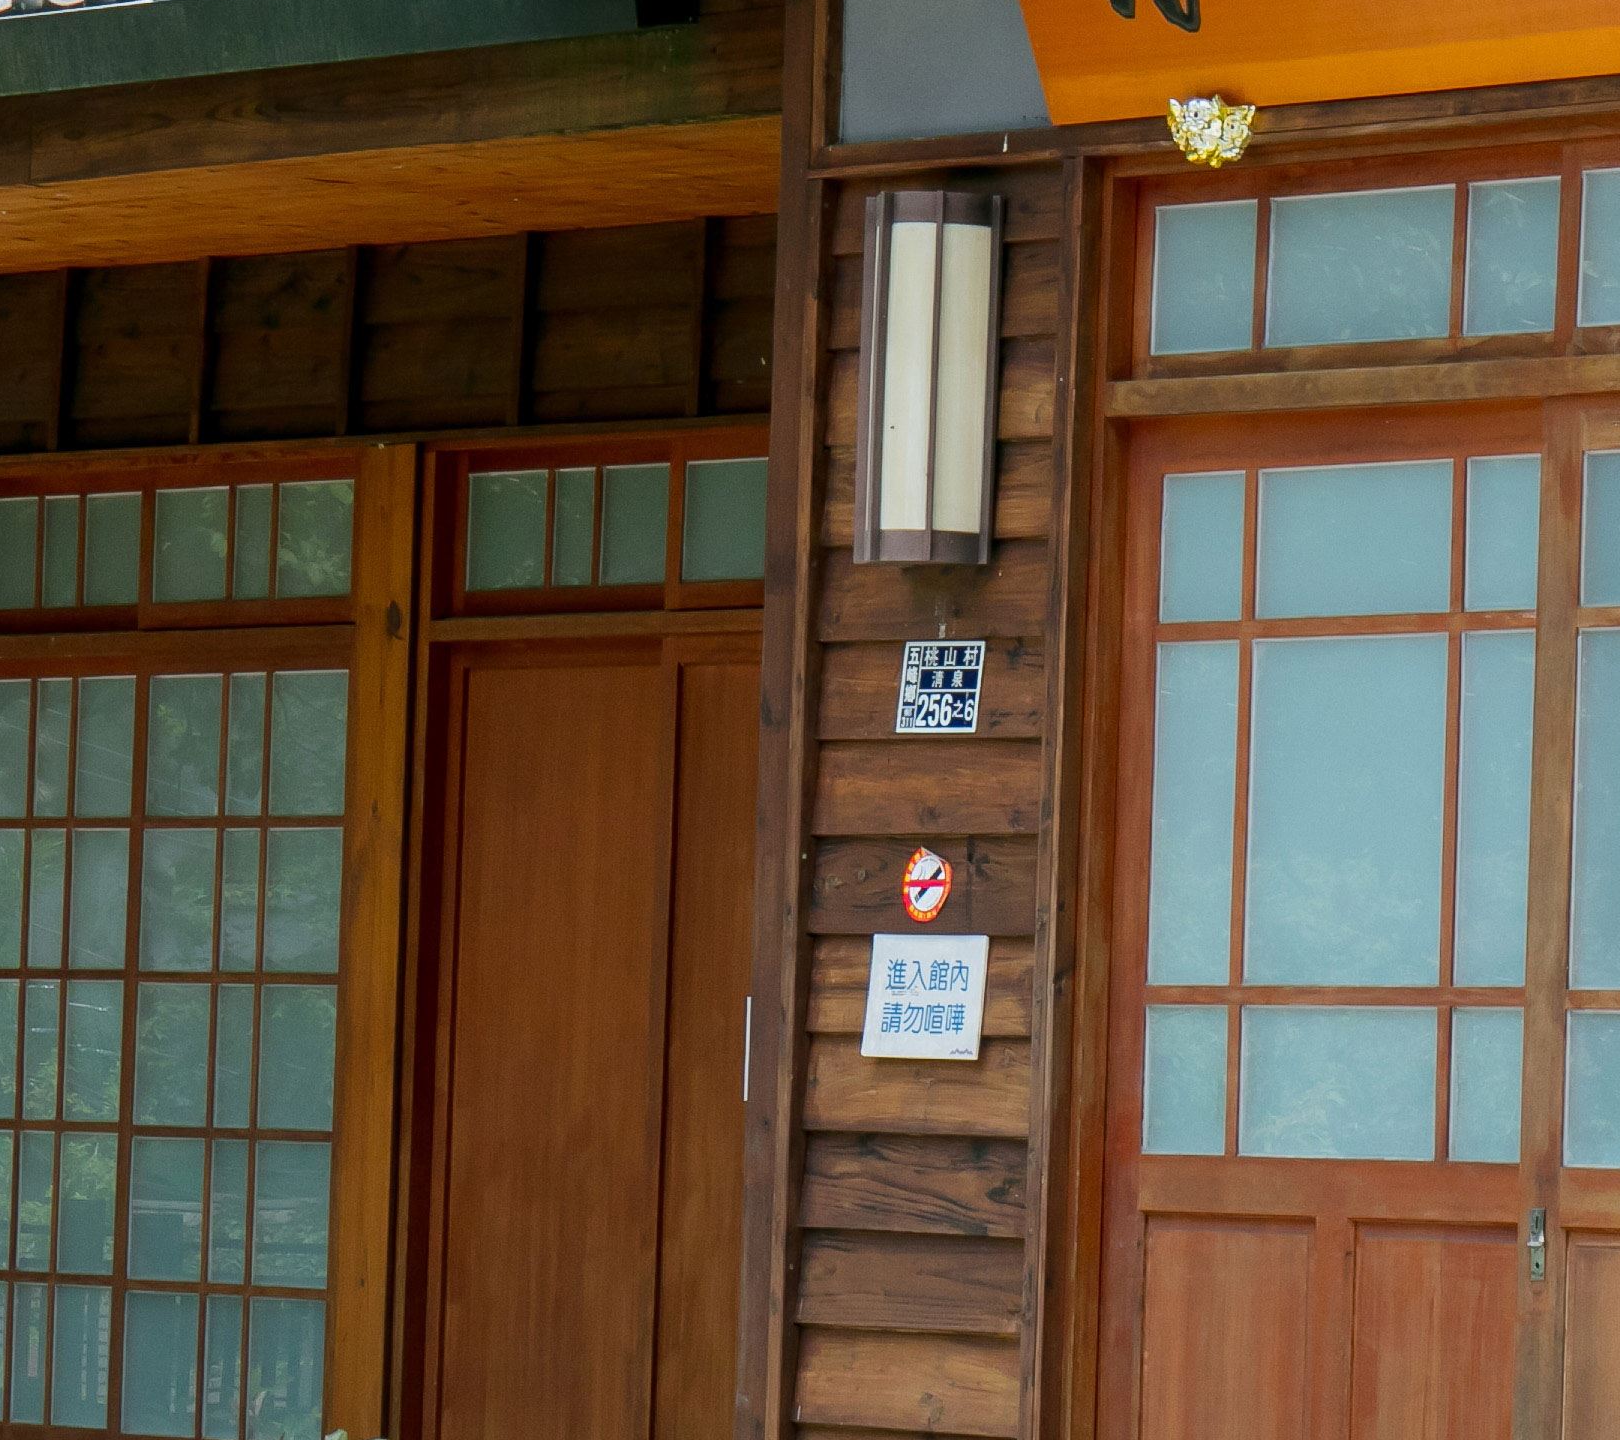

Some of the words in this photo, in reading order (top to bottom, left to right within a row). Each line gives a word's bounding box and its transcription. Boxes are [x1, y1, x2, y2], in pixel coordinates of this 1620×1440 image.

[885, 958, 970, 992] 進入館內
[881, 1002, 966, 1035] 請勿喧嘩
